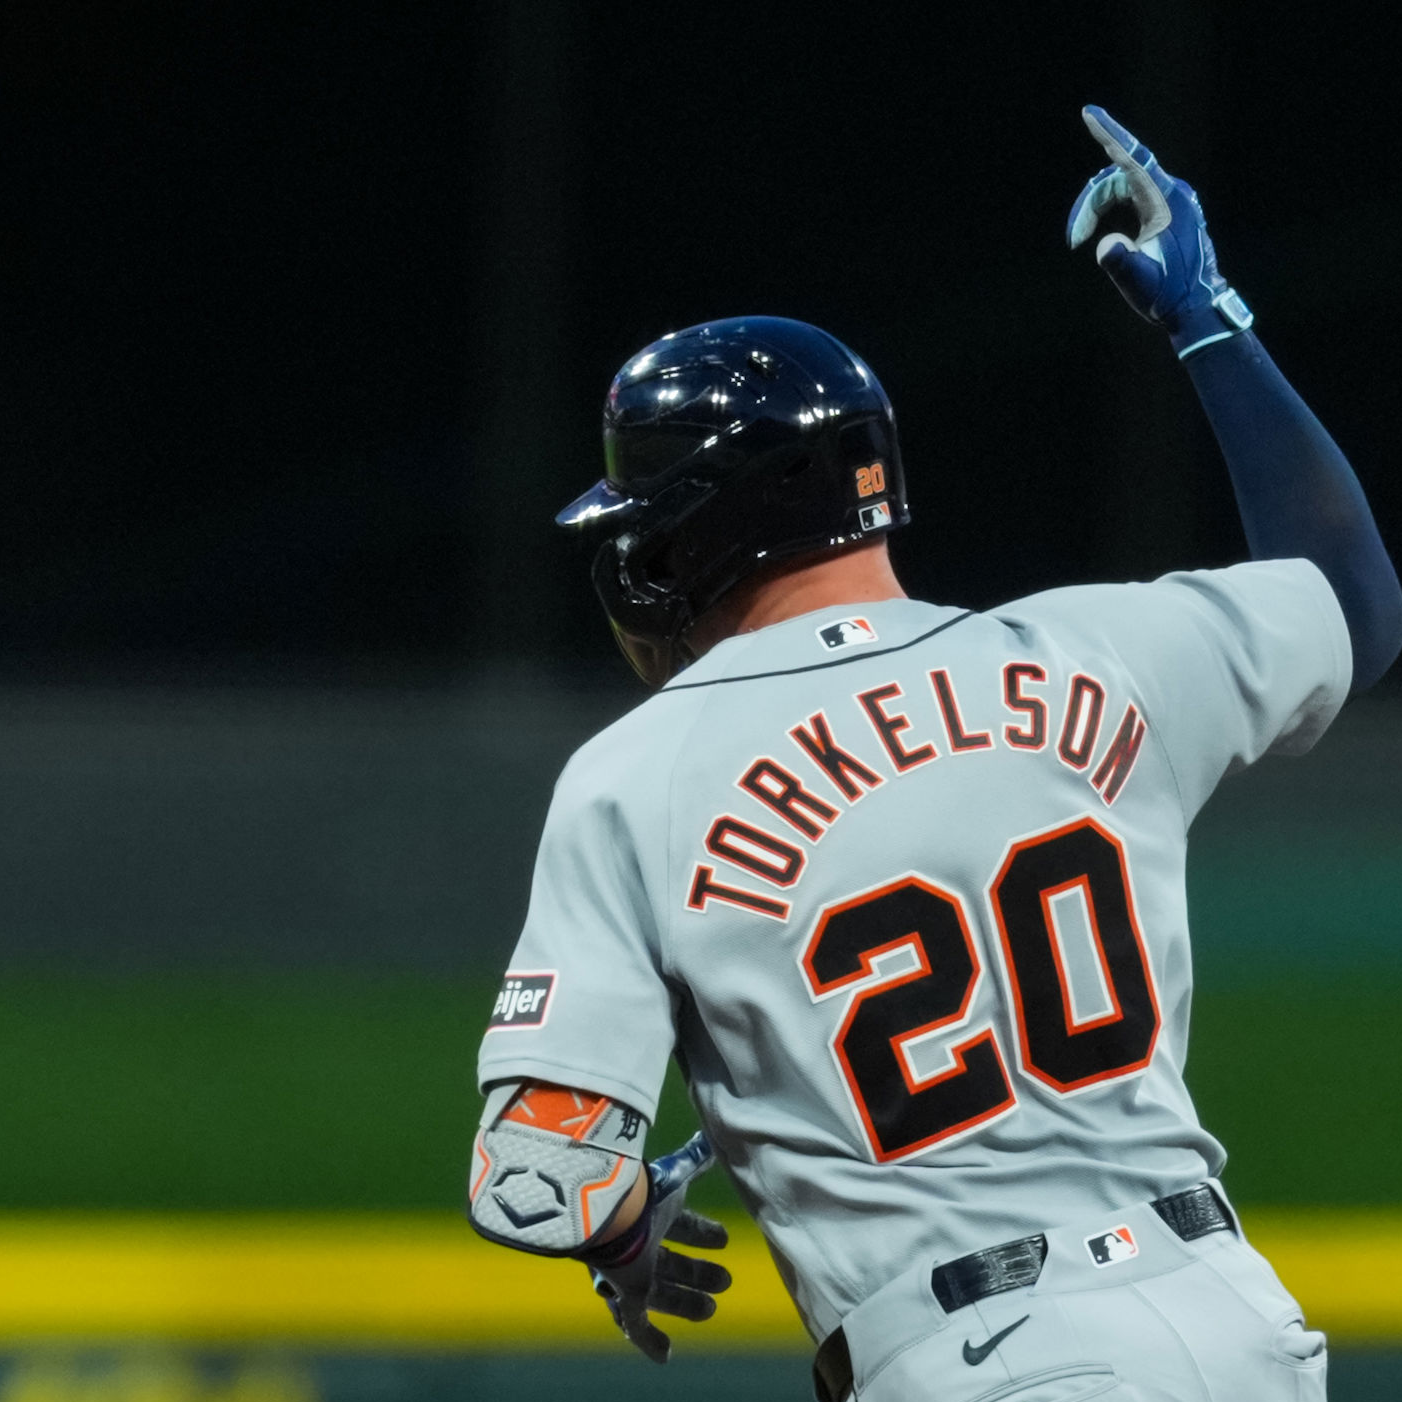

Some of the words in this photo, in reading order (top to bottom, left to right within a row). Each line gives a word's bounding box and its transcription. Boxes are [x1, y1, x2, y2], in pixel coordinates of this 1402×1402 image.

[855, 463, 886, 498] 20
[684, 661, 1146, 923] TORKELSON
[492, 980, 547, 1022] eijer
[798, 815, 1161, 1164] 20
